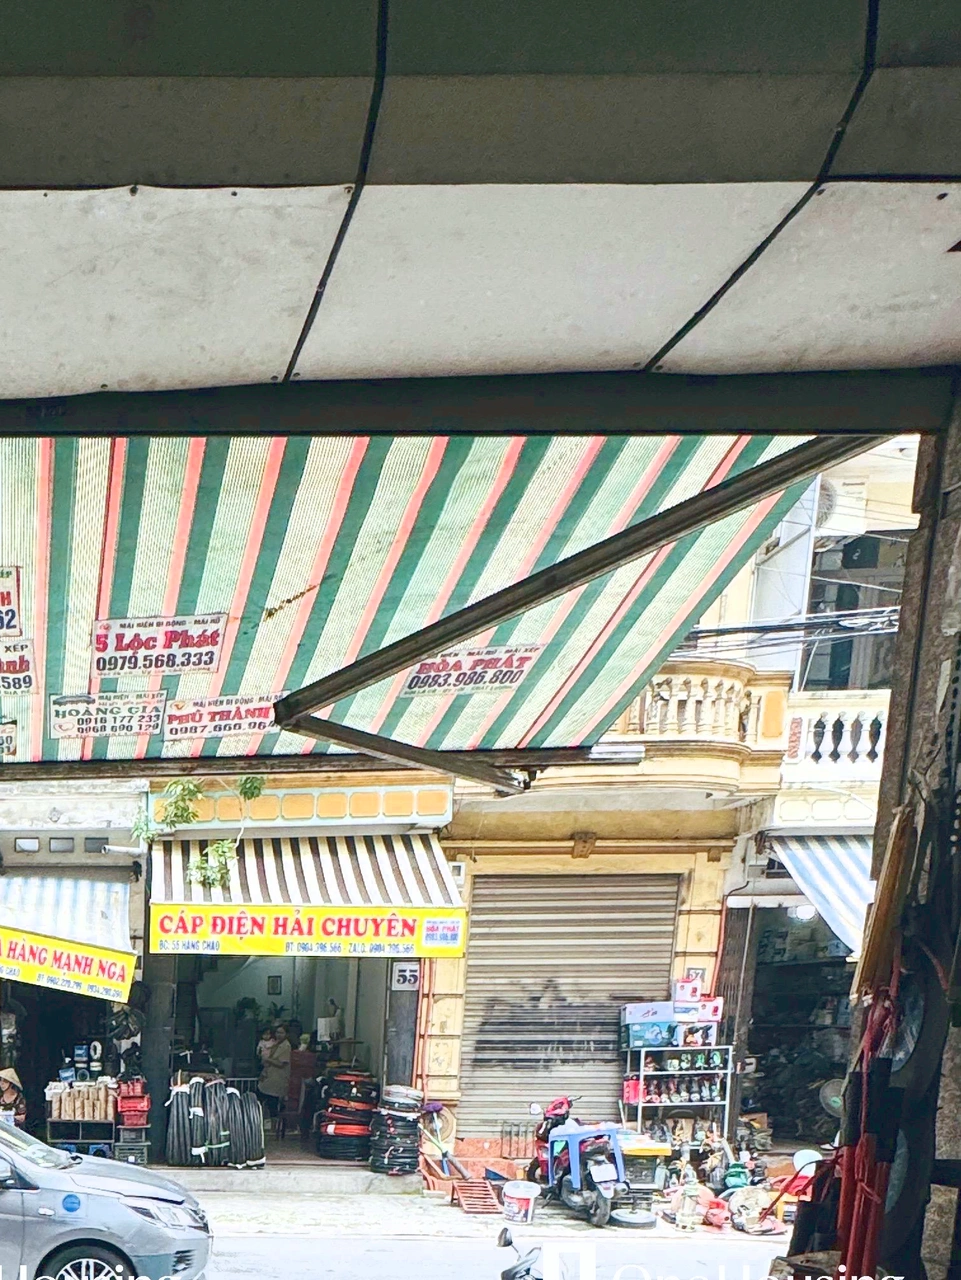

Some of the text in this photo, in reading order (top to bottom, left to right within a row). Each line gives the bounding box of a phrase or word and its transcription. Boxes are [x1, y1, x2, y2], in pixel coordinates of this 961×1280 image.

[114, 633, 158, 656] Lộc
[162, 628, 220, 649] Phát
[96, 650, 215, 671] 0979.568.333
[468, 654, 532, 671] PHÁT
[407, 670, 524, 690] 0983.986.800
[54, 706, 162, 719] HOÀNG GIA
[208, 706, 272, 722] THÀNH
[159, 910, 418, 940] CÁP ĐIỆN HẢI CHUYÊN
[6, 938, 48, 966] HÀNG
[51, 950, 95, 976] MẠNH
[96, 960, 126, 983] NGA
[396, 968, 419, 985] 55
